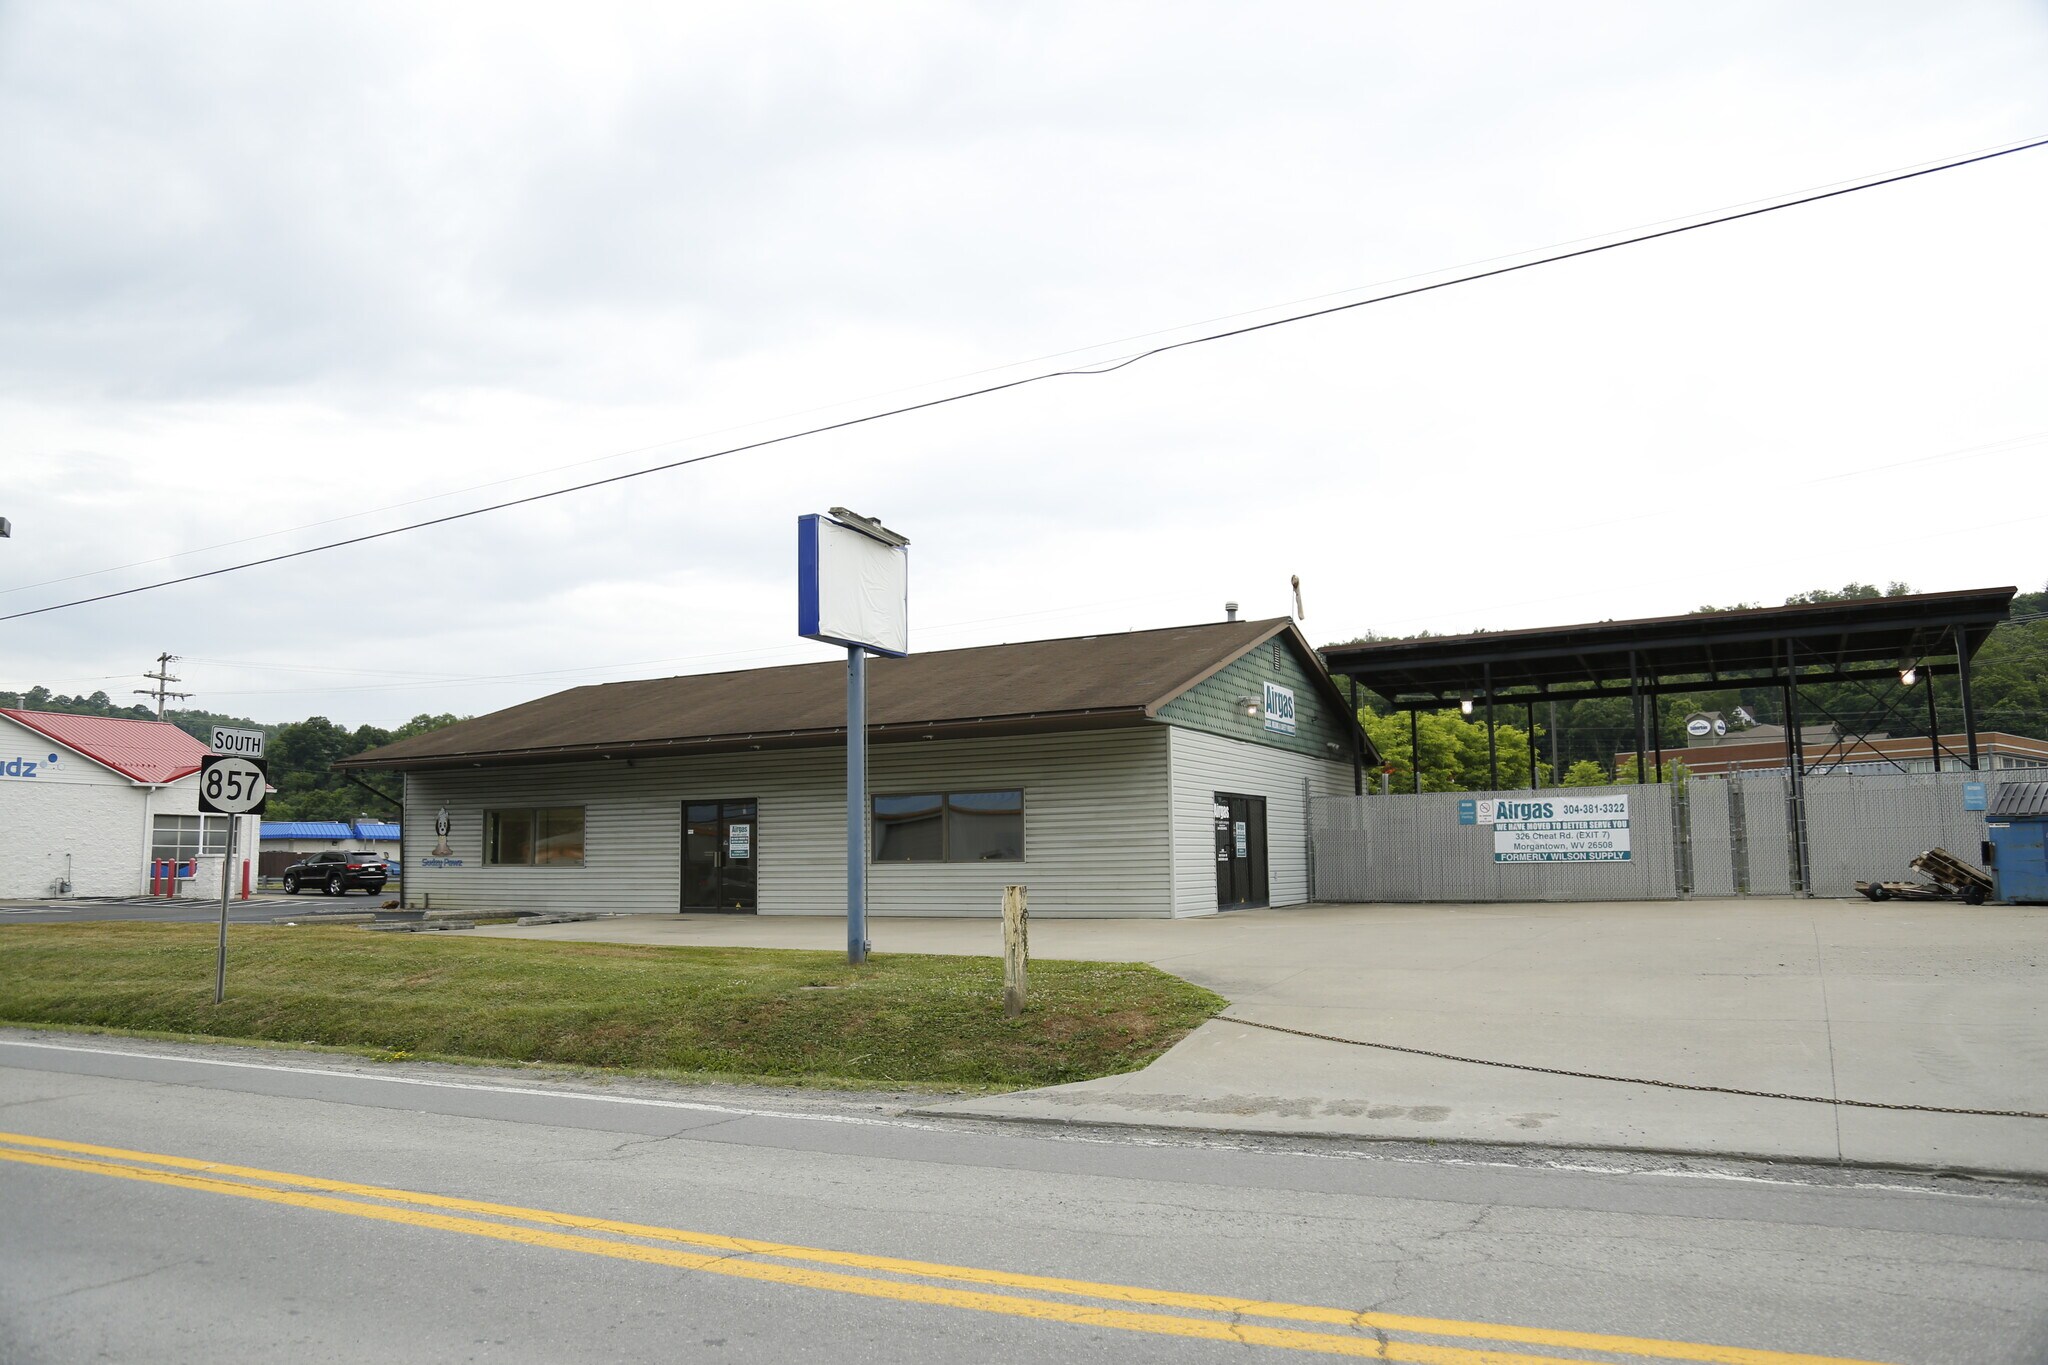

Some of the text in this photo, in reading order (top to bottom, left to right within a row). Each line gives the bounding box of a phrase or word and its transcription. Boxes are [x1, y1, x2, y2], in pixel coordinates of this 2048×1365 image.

[1266, 685, 1294, 719] Airgas
[214, 731, 261, 753] SOUTH
[206, 769, 260, 801] 857
[1496, 801, 1554, 821] Airgas
[1563, 803, 1625, 814] 304-381-3322
[1496, 820, 1627, 831] WE HAVE MOVED TO BETTER SERVE YOU
[1532, 832, 1557, 840] Cheat
[1559, 831, 1574, 839] Rd.
[1576, 831, 1599, 840] (EXIT
[1602, 831, 1611, 839] 7)
[1513, 843, 1569, 851] Morgantown,
[1588, 841, 1613, 849] 26508
[1501, 851, 1625, 861] FORMERLY WILSON SUPPLY
